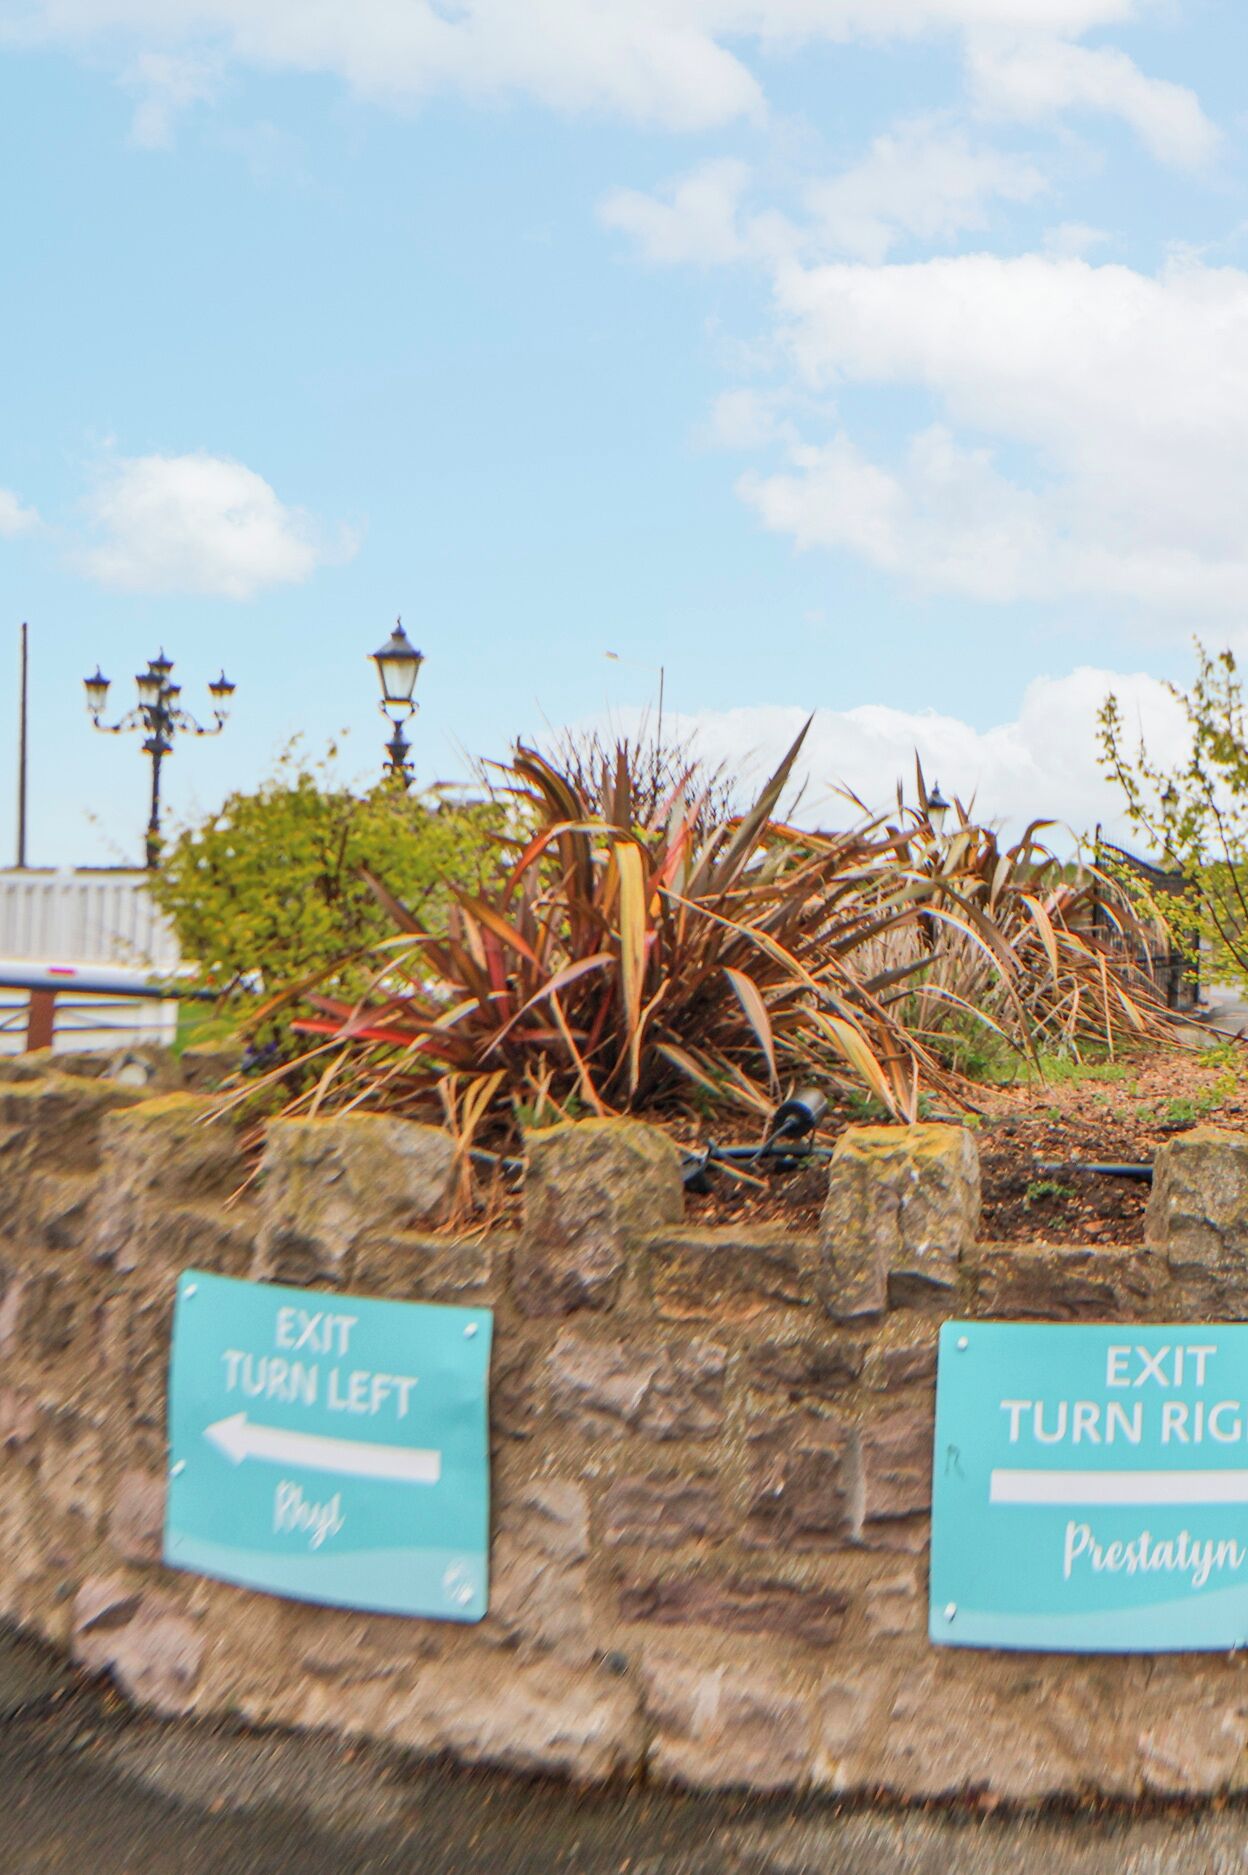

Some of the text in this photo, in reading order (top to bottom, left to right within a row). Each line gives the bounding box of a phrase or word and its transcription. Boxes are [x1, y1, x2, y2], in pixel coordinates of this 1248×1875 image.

[275, 1307, 358, 1356] EXIT
[222, 1349, 419, 1419] TURN LEFT
[1105, 1344, 1218, 1387] EXIT
[1000, 1399, 1144, 1444] TURN
[1062, 1519, 1247, 1588] Prestatyn
